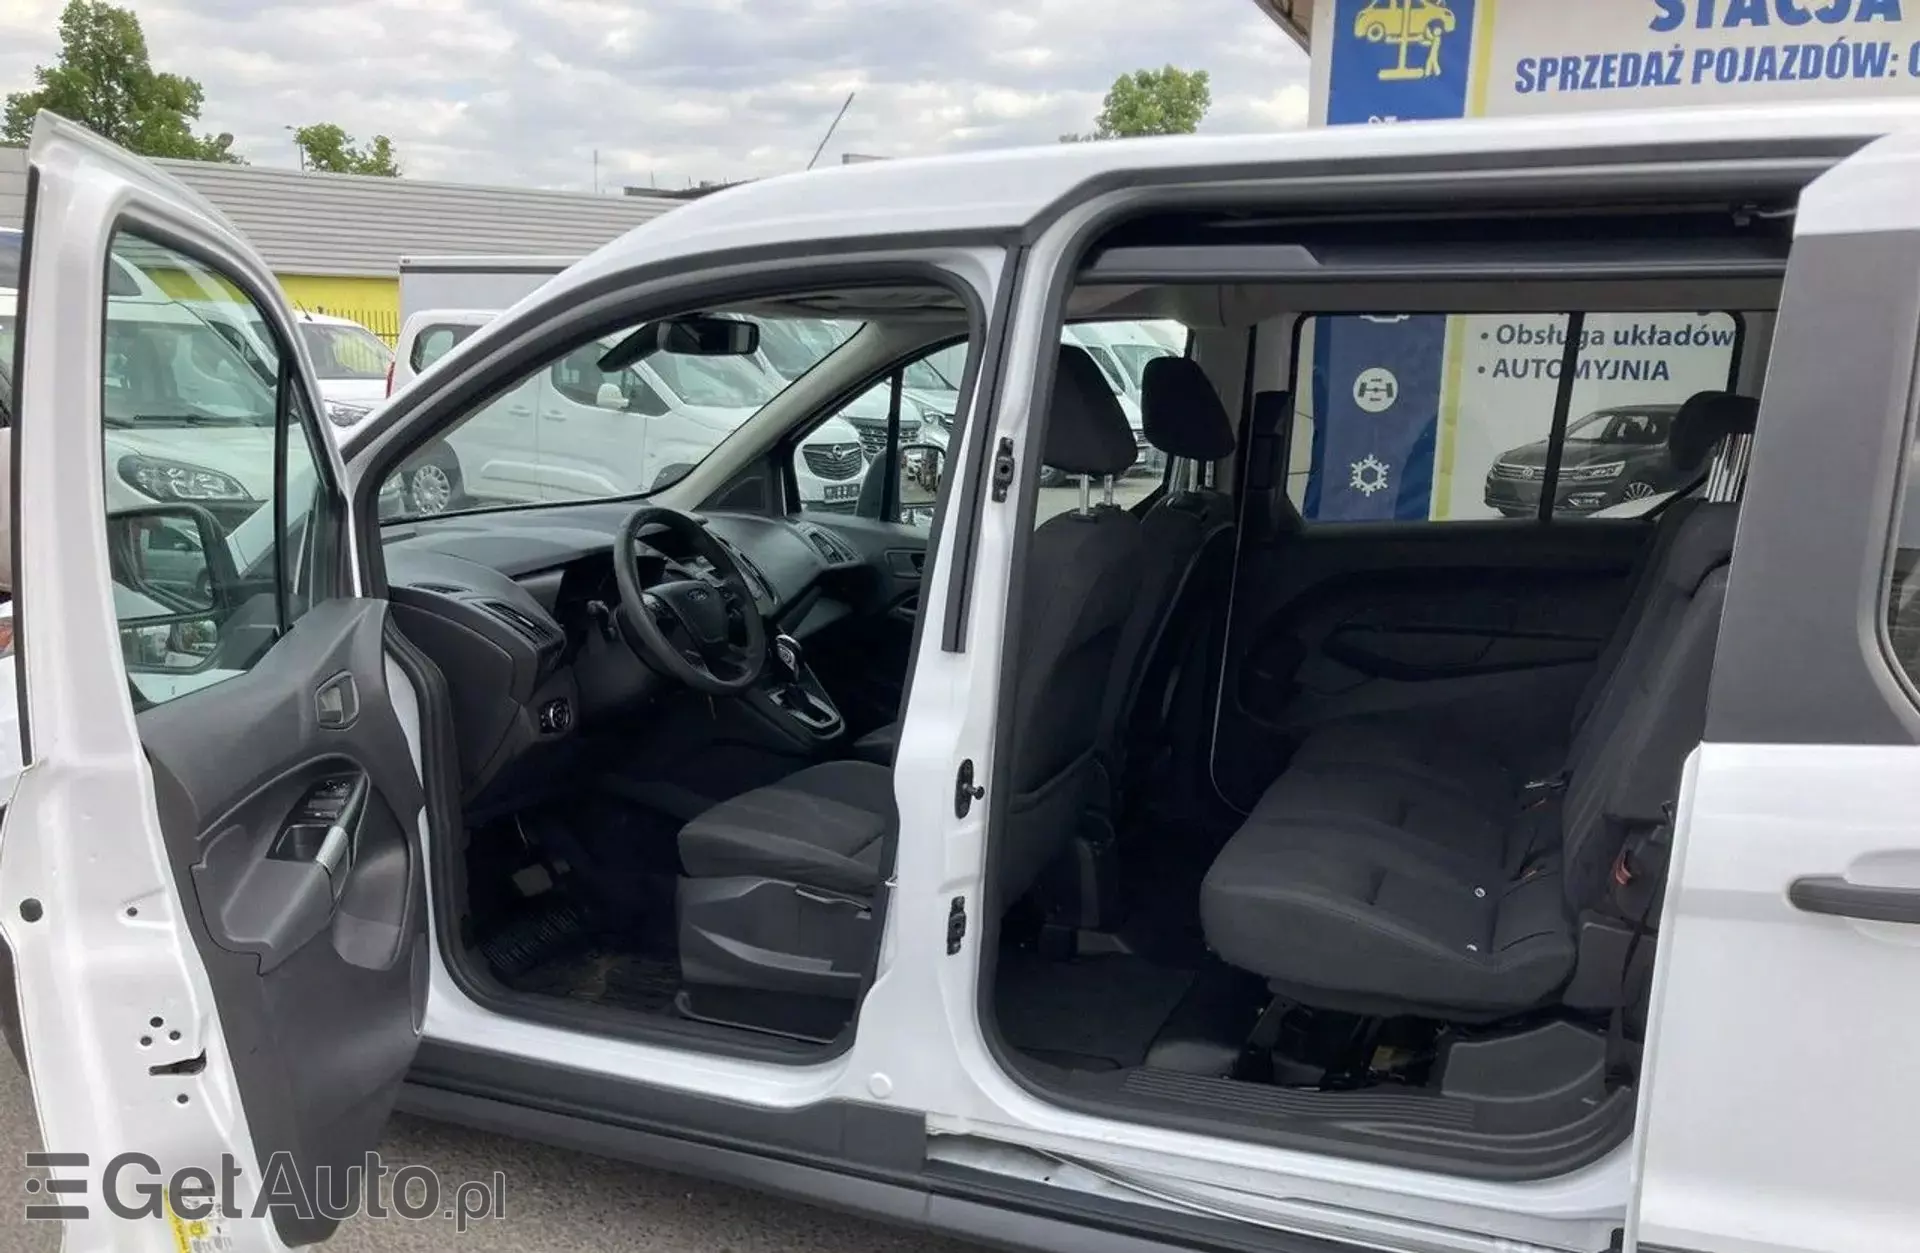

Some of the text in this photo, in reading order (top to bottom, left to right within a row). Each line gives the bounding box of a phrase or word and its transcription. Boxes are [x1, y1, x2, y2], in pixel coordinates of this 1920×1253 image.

[1515, 43, 1683, 93] SPRZEDAŻ
[1691, 36, 1899, 84] POJAZDÓW:
[1496, 323, 1733, 351] Obsługa układów
[1492, 358, 1670, 381] AUTOMYJNIA
